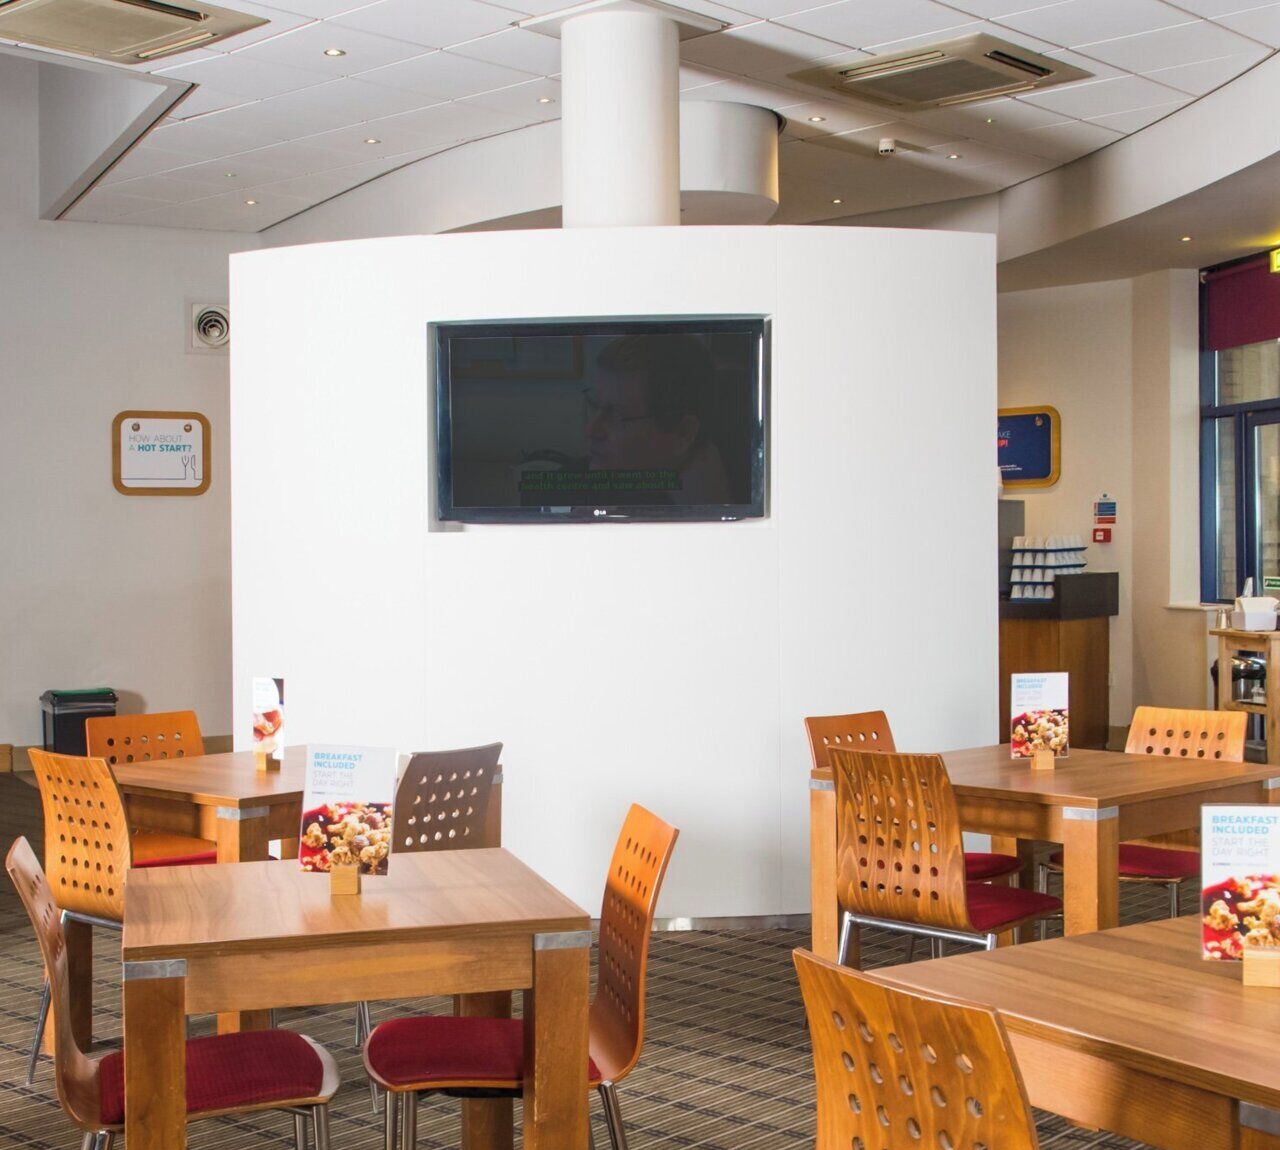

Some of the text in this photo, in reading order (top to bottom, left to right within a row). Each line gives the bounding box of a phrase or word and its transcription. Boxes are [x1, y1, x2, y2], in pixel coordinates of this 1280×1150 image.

[128, 434, 182, 443] HOW ABOUT
[128, 444, 192, 453] A HOT START?
[314, 752, 362, 761] BREAKFAST
[314, 761, 355, 769] INCLUDED
[1212, 815, 1279, 825] BREAKFAST
[1212, 825, 1269, 834] INCLUDED
[1212, 836, 1269, 847] START THE
[1212, 847, 1269, 857] DAY RIGHT
